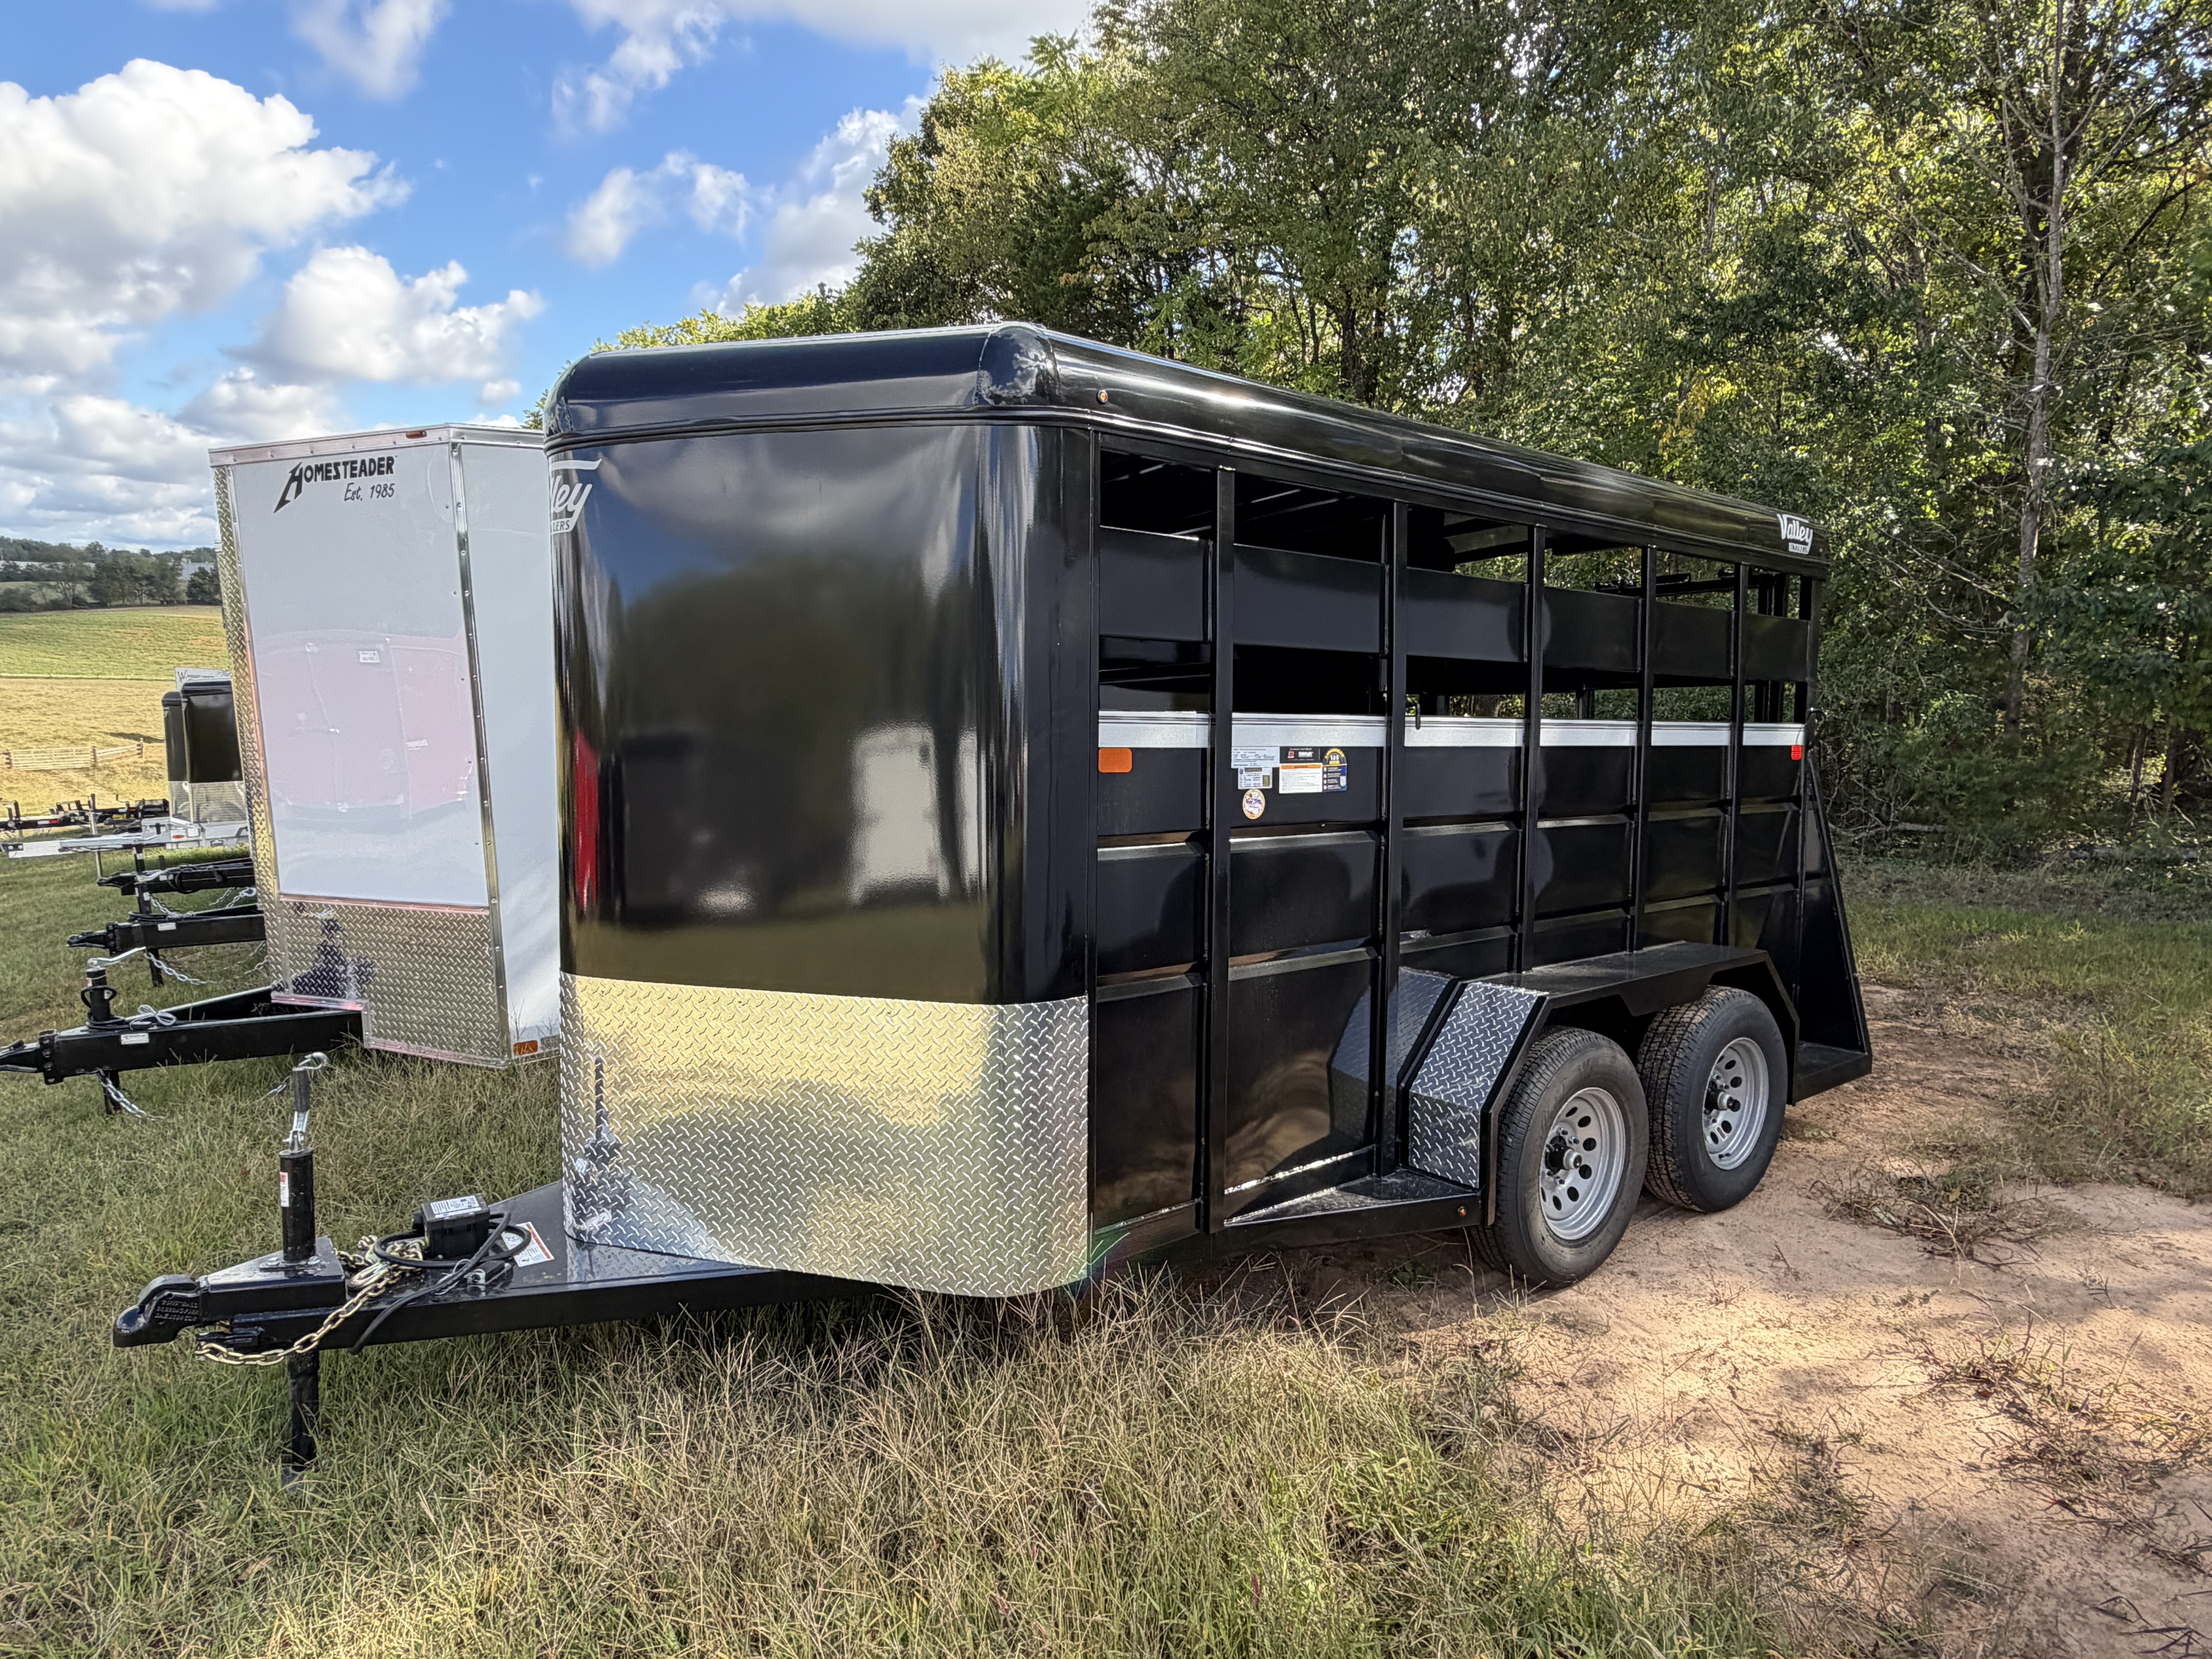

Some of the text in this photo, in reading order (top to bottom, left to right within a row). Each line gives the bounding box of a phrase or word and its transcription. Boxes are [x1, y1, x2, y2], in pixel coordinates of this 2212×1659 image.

[274, 456, 394, 514] HOMESTEADER
[344, 483, 395, 501] Est. 1985
[1776, 514, 1813, 554] Valley
